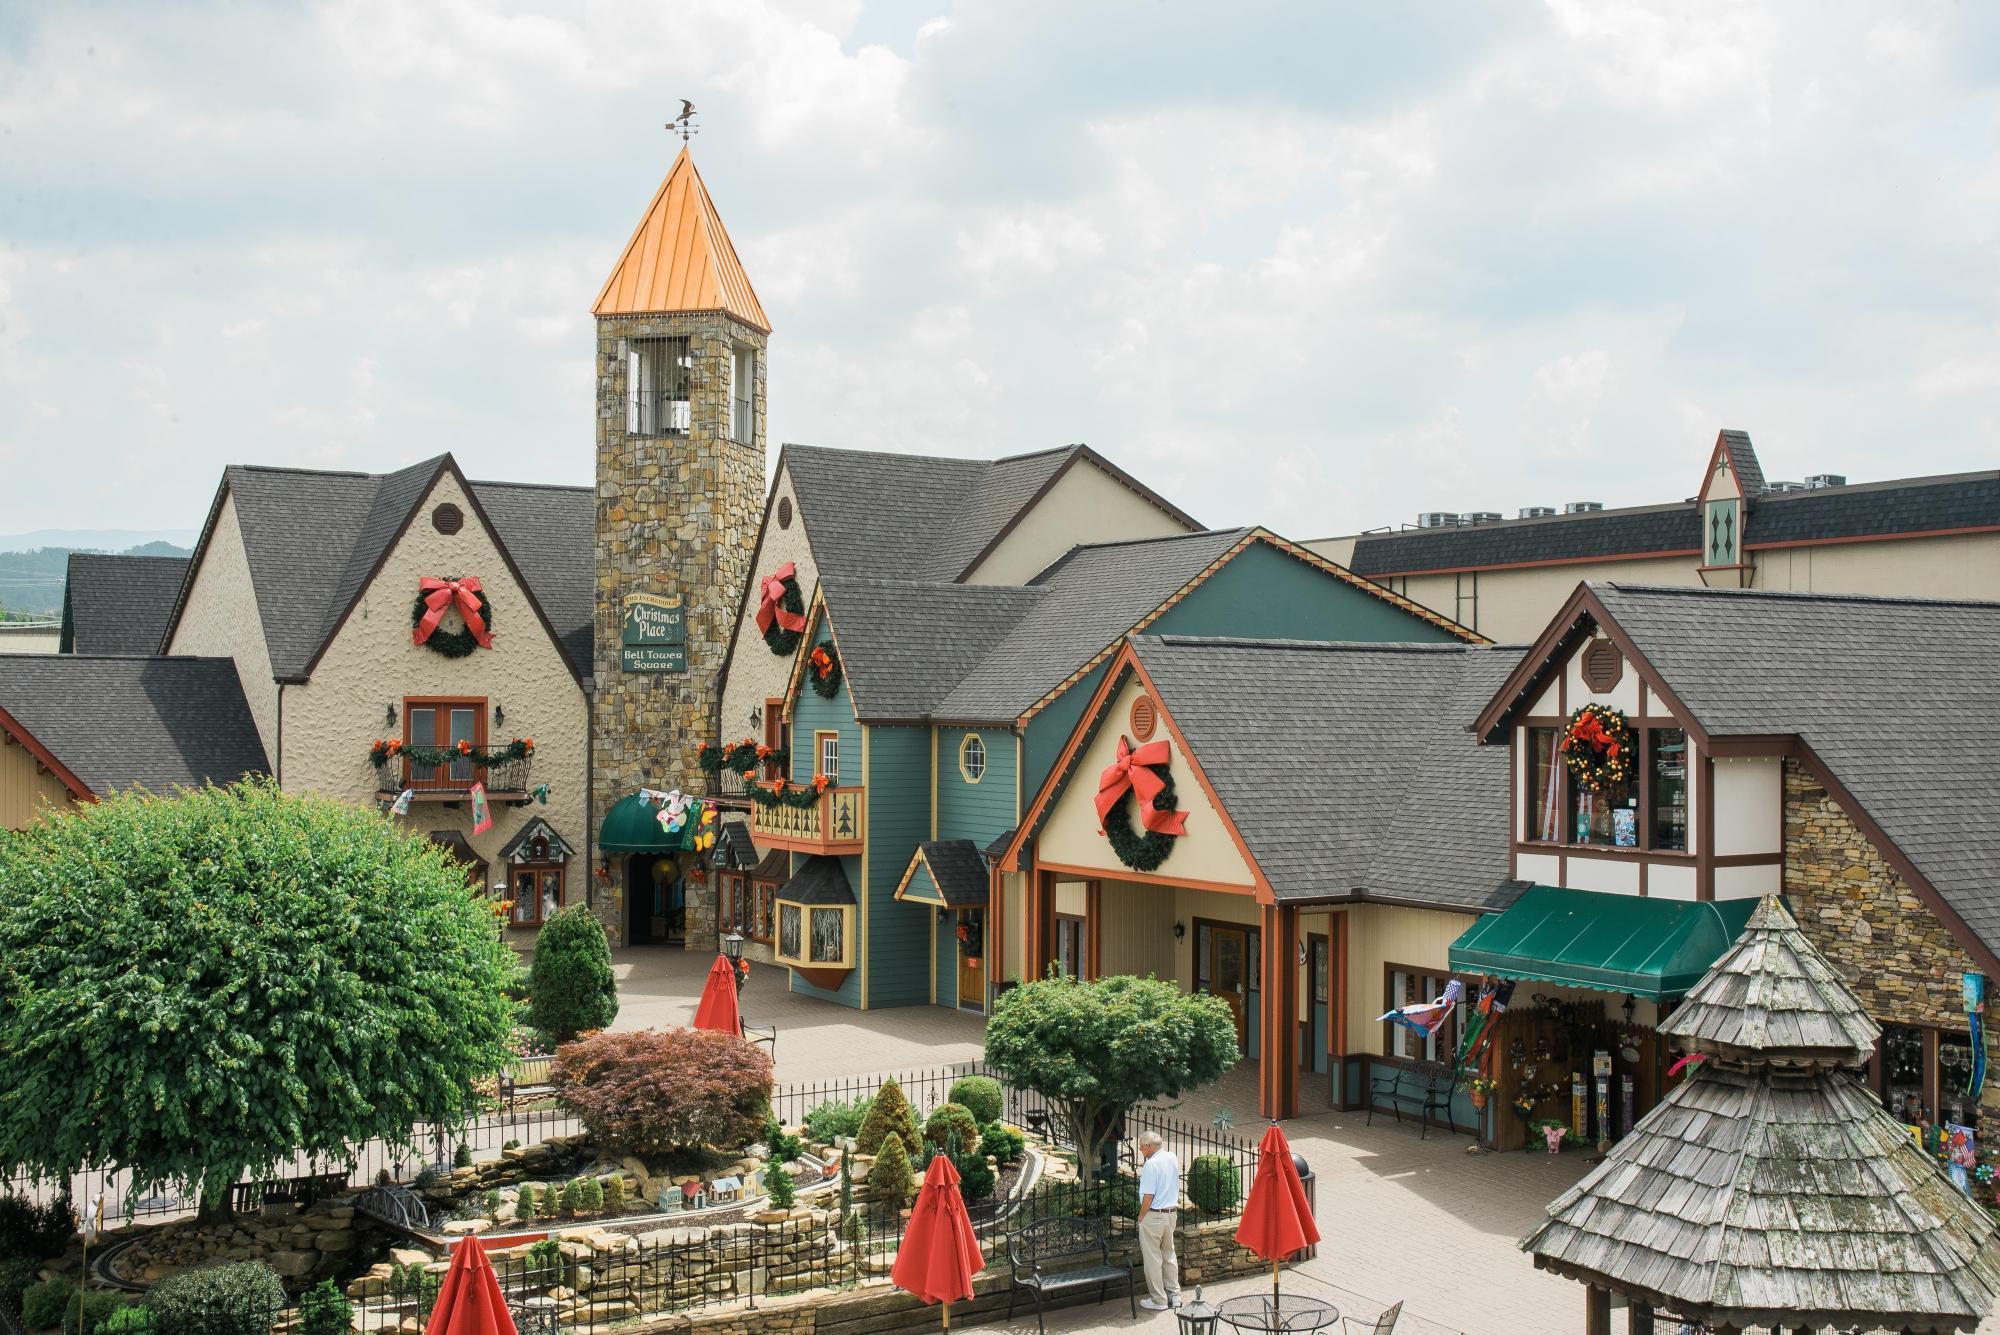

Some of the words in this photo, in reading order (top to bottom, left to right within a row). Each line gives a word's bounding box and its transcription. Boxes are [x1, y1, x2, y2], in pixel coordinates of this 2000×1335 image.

[634, 604, 679, 624] Christmas
[639, 620, 666, 641] Place
[624, 650, 644, 660] Bell
[647, 651, 683, 659] Tower
[633, 660, 673, 670] Square
